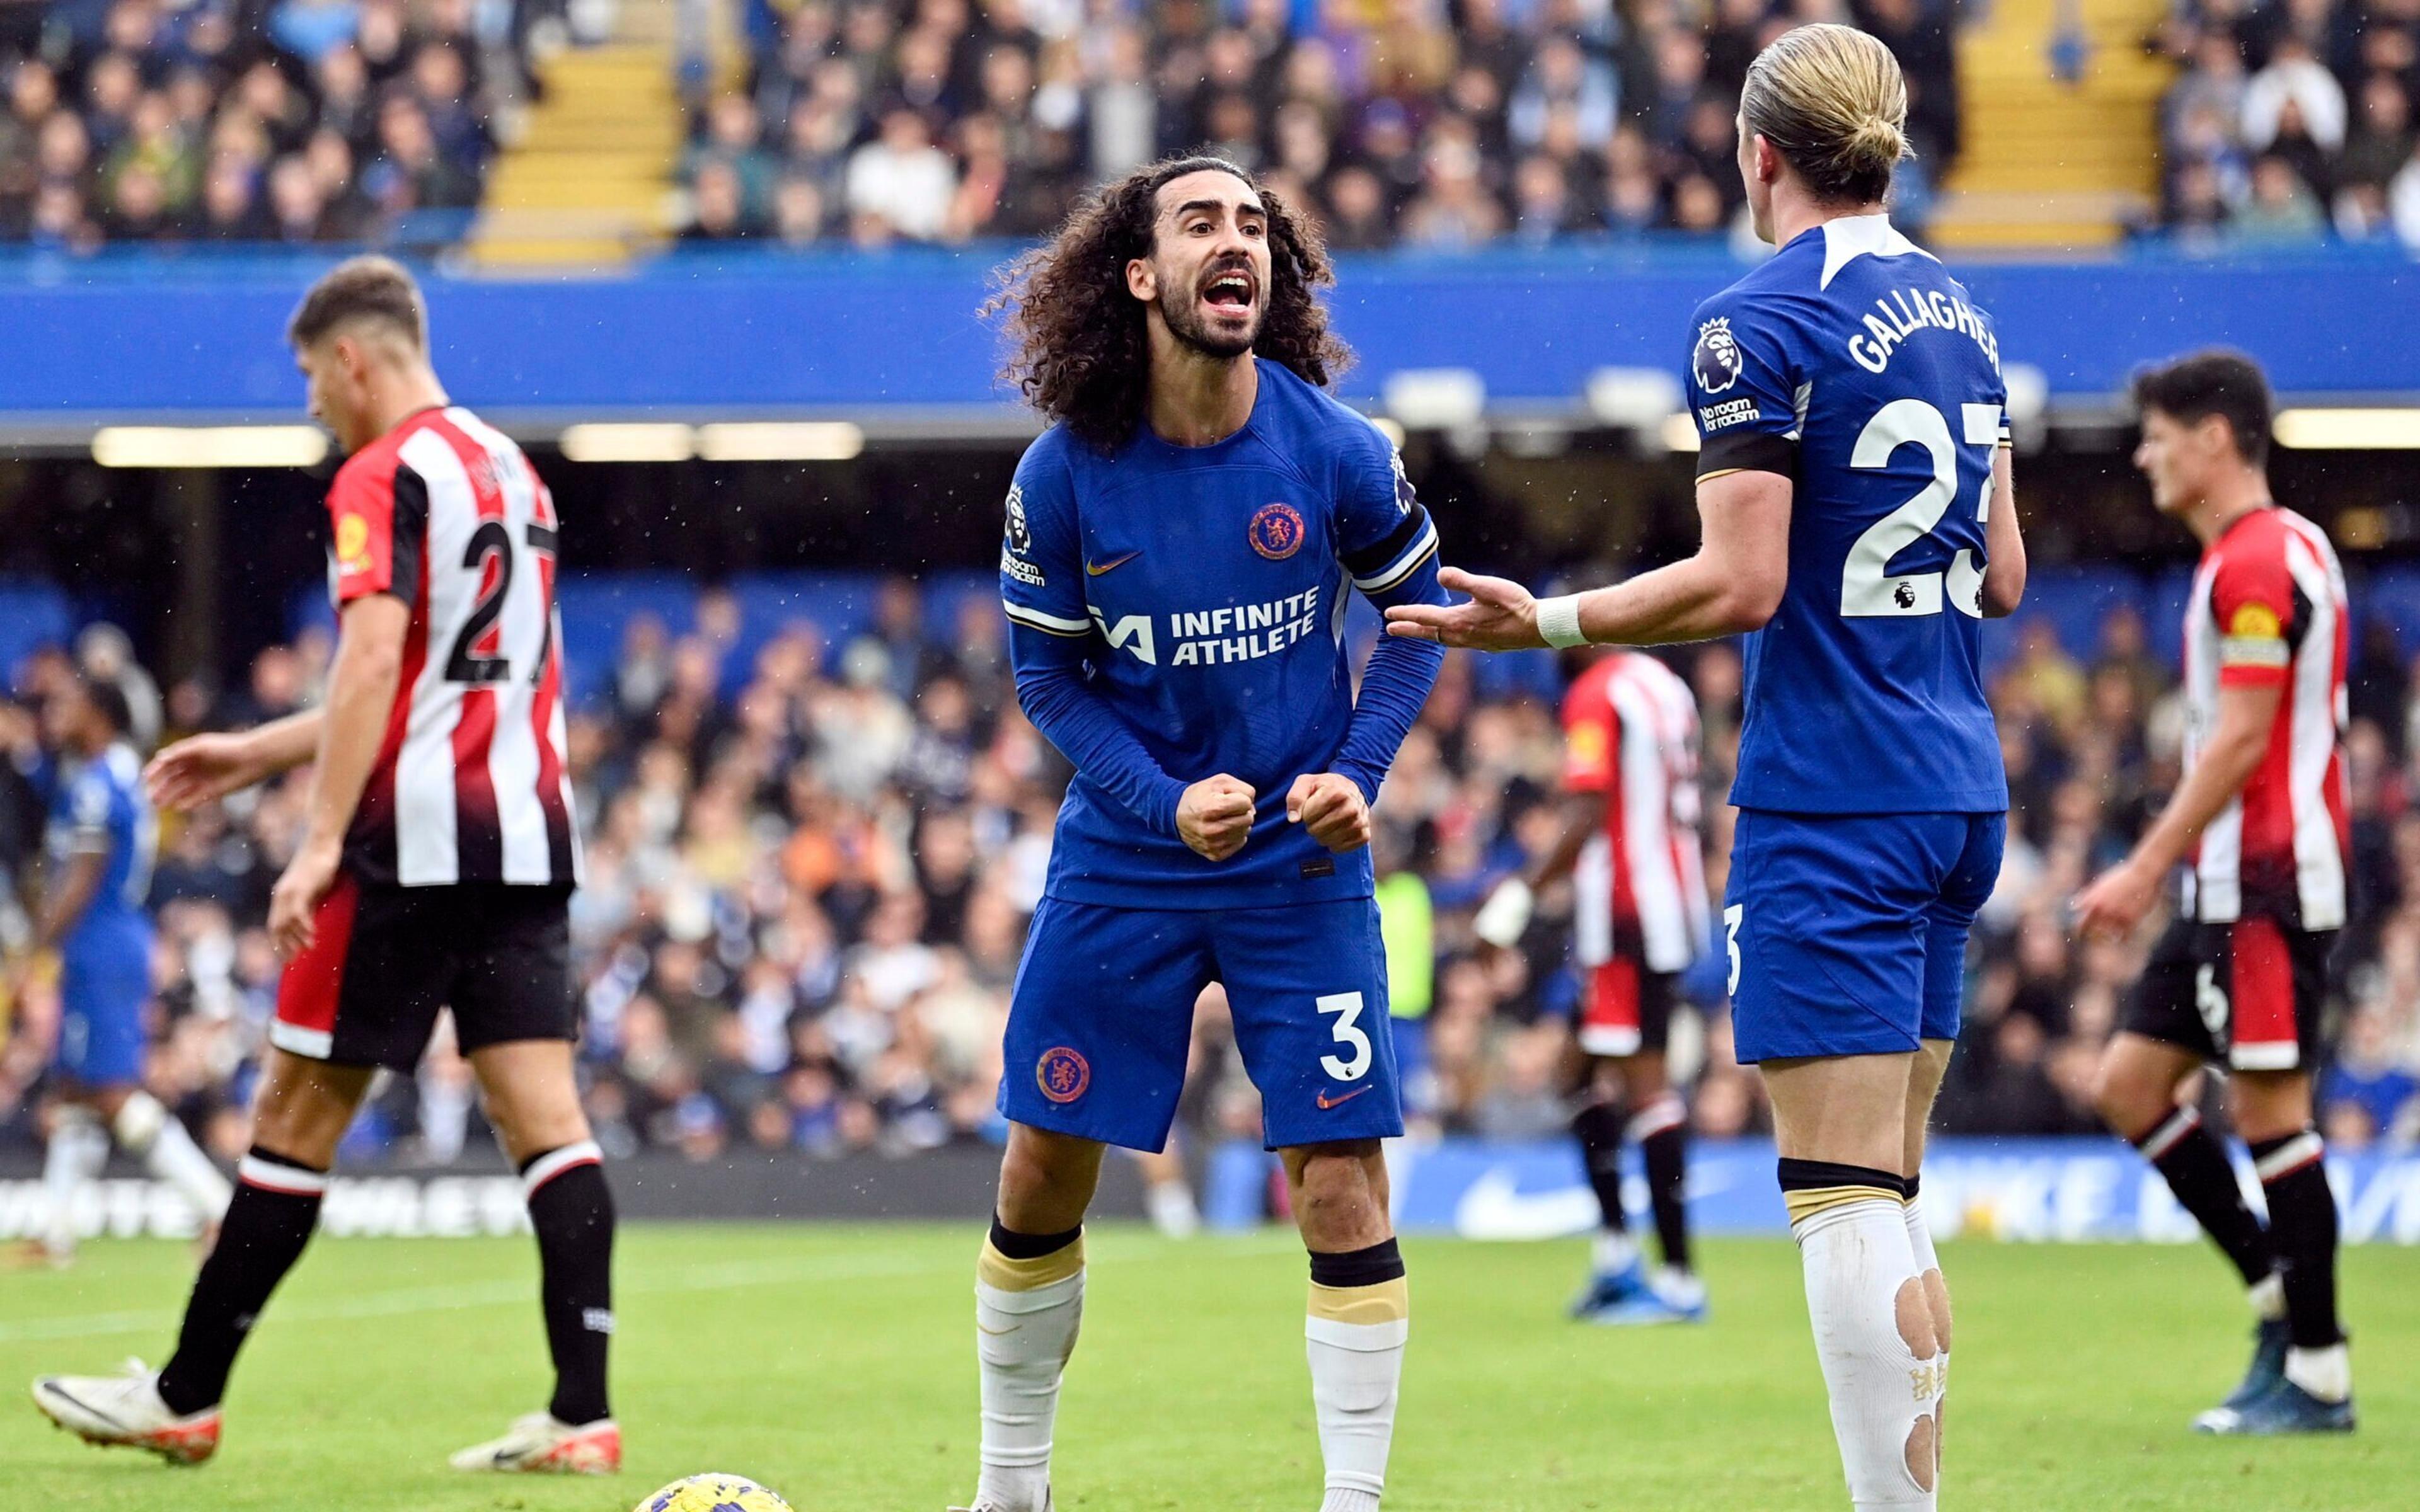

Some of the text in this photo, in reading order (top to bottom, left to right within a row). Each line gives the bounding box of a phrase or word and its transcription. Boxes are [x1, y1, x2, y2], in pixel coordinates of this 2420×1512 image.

[1849, 289, 2000, 375] GALLAGHER
[1699, 398, 1751, 420] No room
[1702, 409, 1760, 432] for racism
[1010, 570, 1045, 587] racism
[1172, 585, 1320, 638] INFINITE
[1172, 609, 1316, 666] ATHLETE
[1316, 991, 1372, 1082] 3
